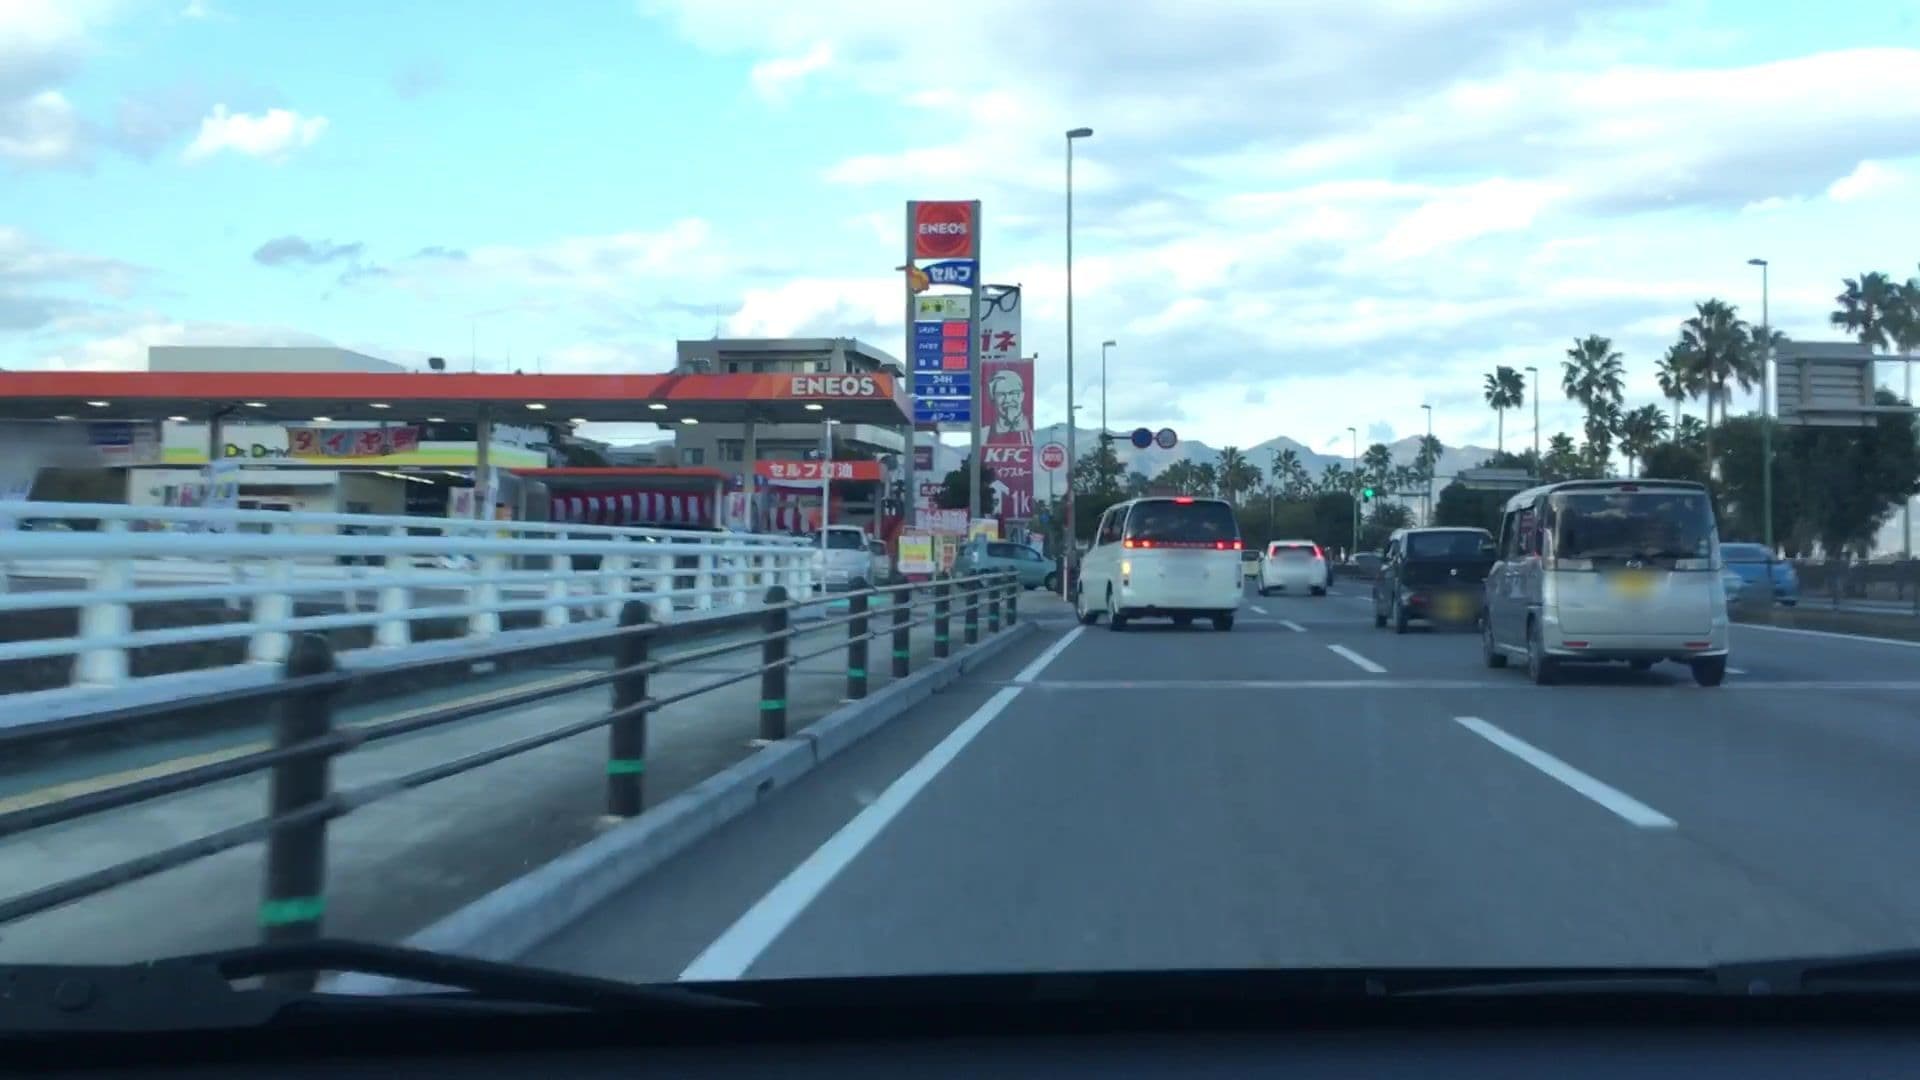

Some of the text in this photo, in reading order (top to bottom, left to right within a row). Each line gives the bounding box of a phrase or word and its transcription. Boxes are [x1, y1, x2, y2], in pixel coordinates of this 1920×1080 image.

[919, 222, 967, 235] ENEOS
[930, 266, 971, 282] セルフ
[791, 376, 874, 396] ENEOS
[984, 448, 1029, 463] KFC
